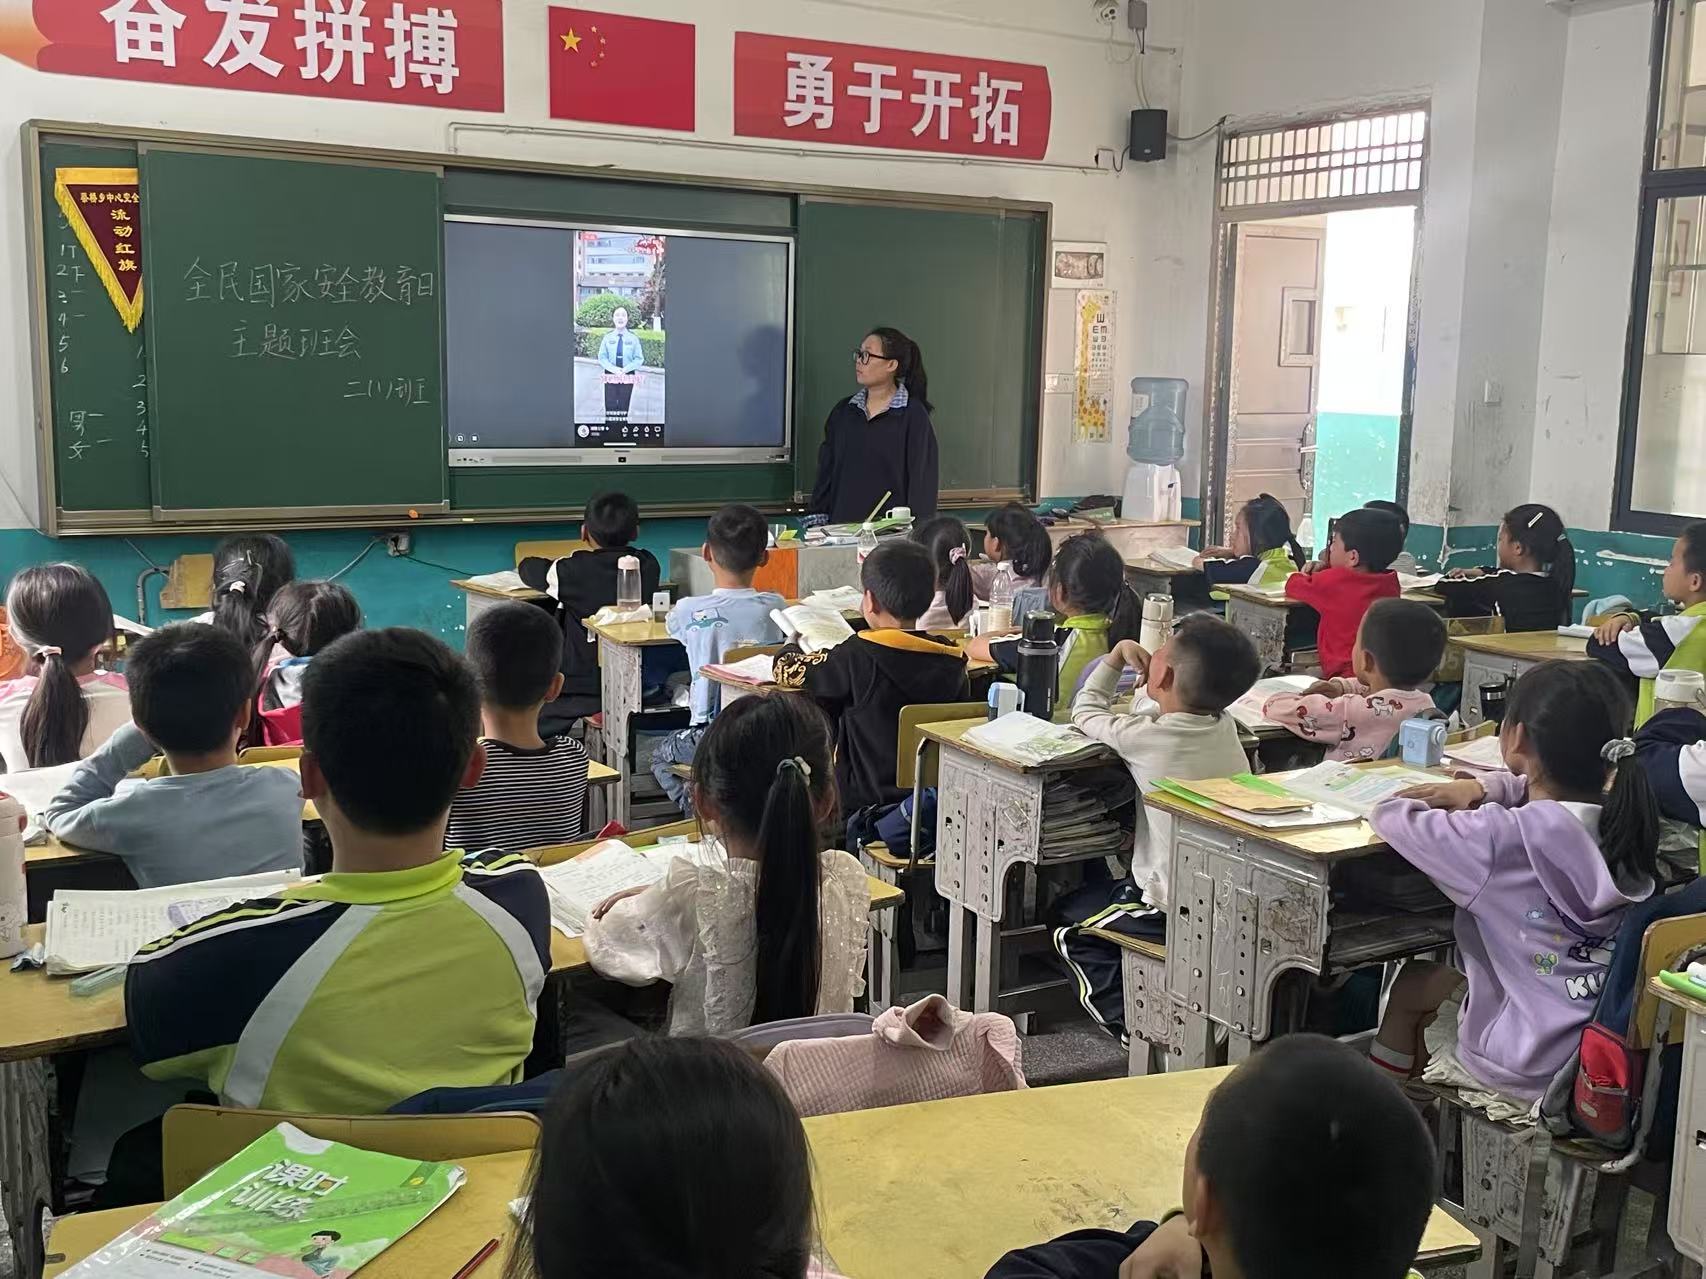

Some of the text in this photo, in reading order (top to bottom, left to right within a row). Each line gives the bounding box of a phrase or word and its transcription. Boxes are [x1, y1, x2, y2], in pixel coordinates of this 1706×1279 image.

[100, 0, 460, 94] 奋发拼搏
[782, 52, 1023, 146] 勇于开拓
[110, 208, 137, 272] 流动红旗
[183, 257, 434, 308] 全民国家安全教育日
[60, 357, 69, 373] 6
[230, 319, 362, 360] 主题班会
[262, 1159, 349, 1195] 课时
